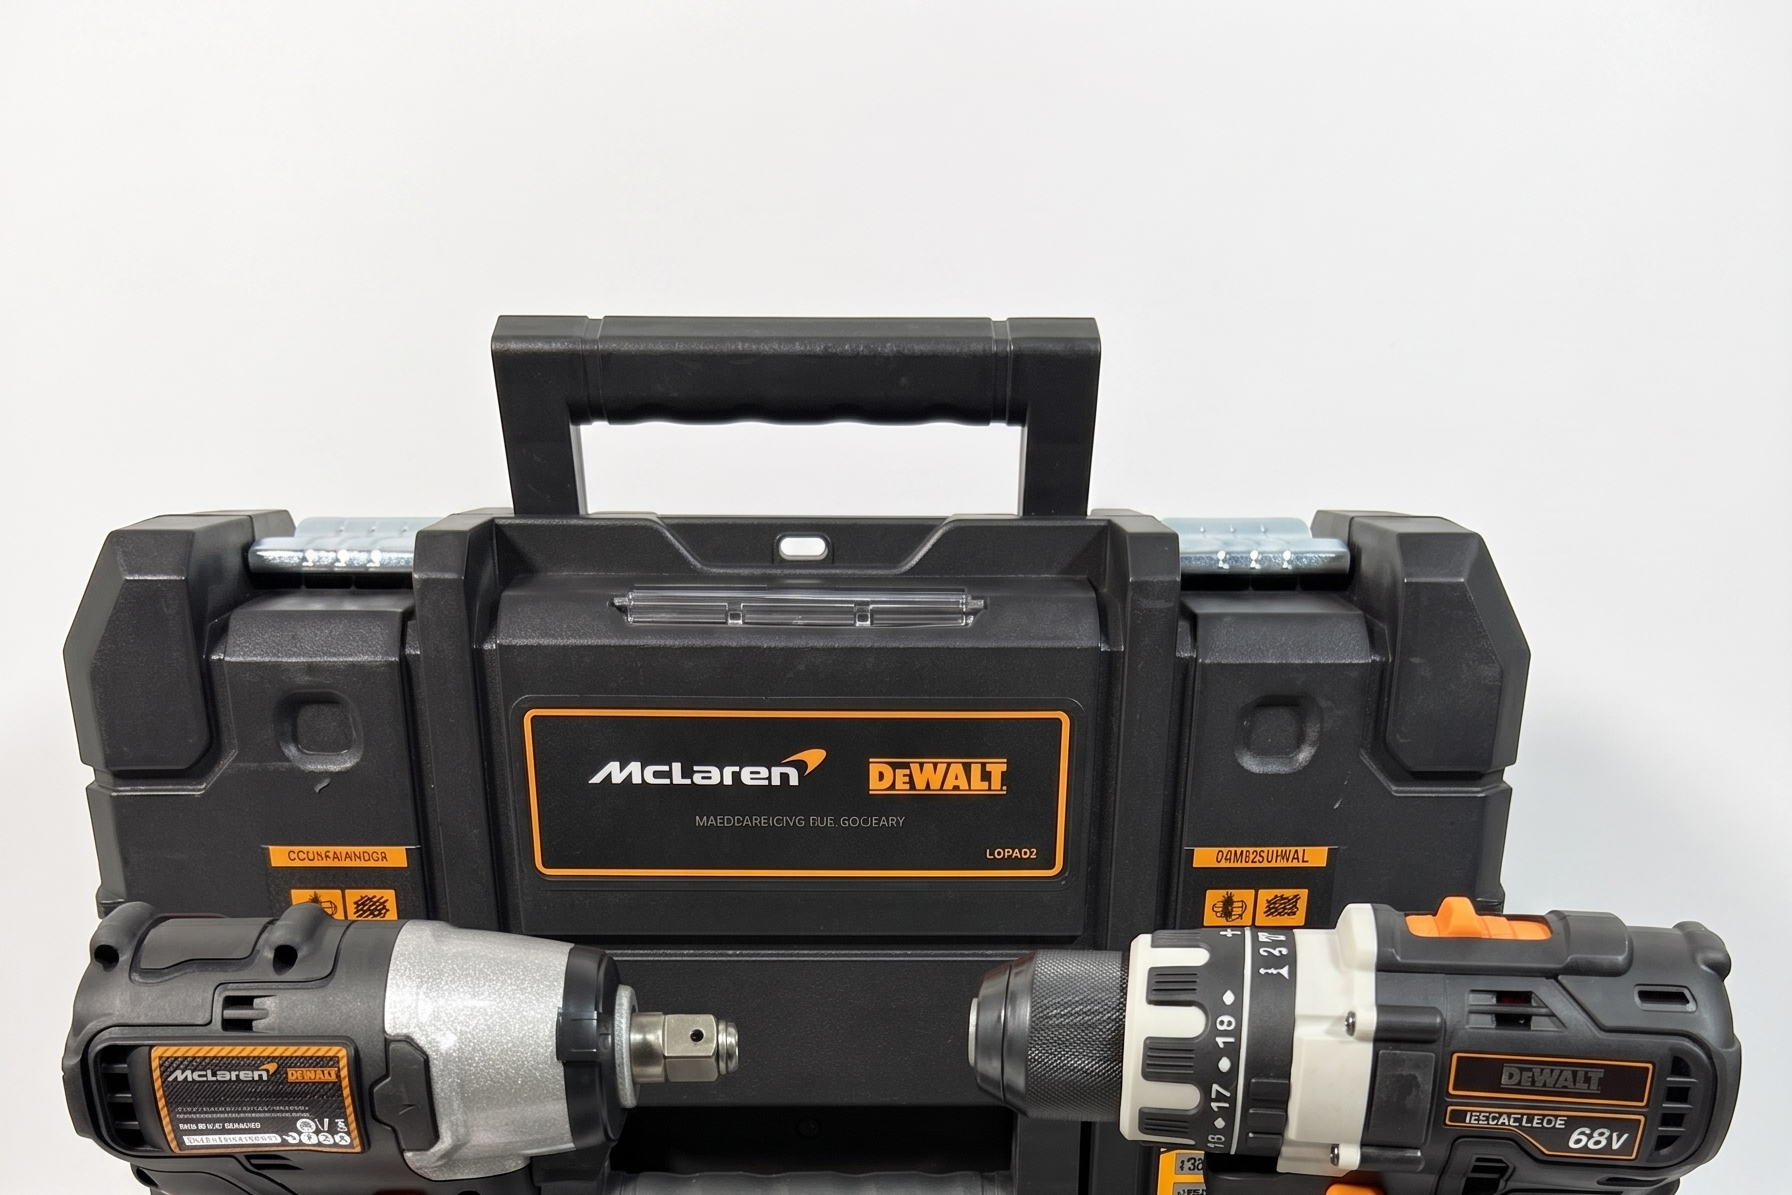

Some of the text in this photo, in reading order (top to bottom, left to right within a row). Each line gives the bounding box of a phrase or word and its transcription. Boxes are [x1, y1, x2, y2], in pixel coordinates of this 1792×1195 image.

[588, 761, 799, 786] McLaren
[167, 1069, 268, 1082] McLaren
[1210, 1083, 1231, 1112] 17
[1568, 1127, 1629, 1151] 68V
